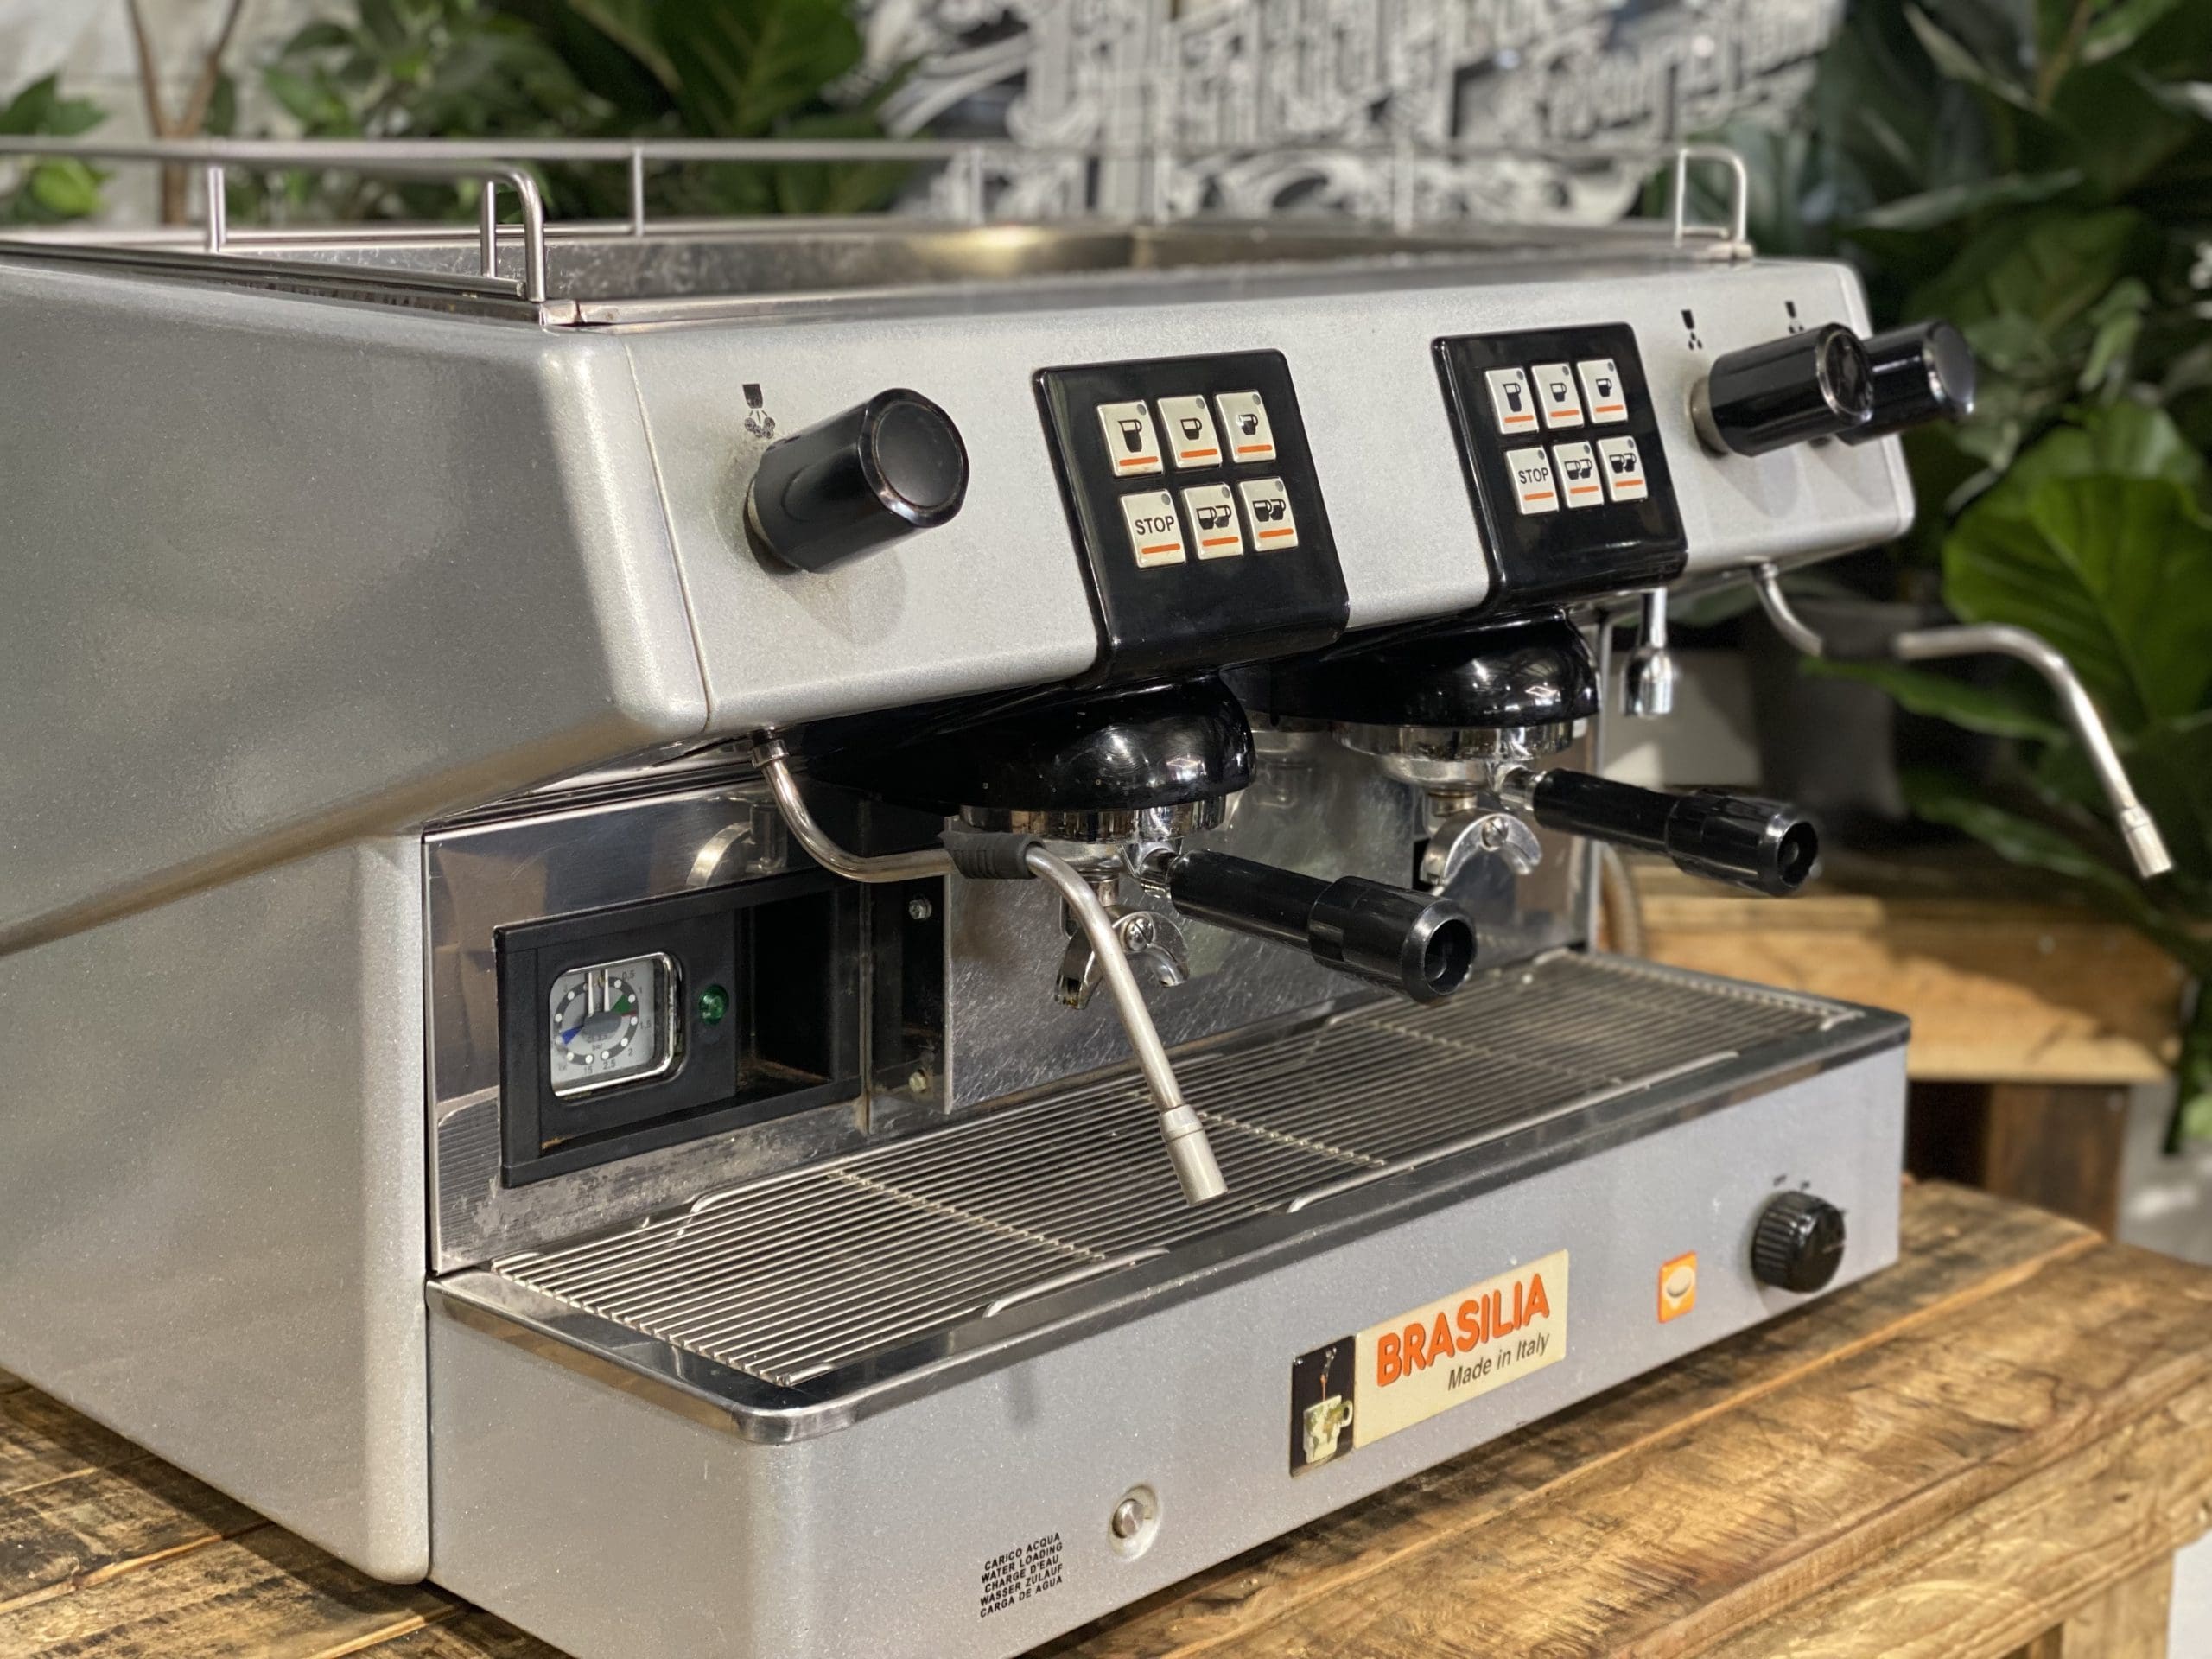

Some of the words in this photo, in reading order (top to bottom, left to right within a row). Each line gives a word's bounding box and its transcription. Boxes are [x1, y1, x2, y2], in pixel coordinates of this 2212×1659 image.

[1518, 467, 1548, 484] STOP
[1135, 516, 1174, 535] STOP
[1377, 1273, 1550, 1388] BRASILIA
[1448, 1357, 1492, 1391] Made
[1497, 1348, 1511, 1370] in
[1516, 1332, 1550, 1362] Italy
[981, 1562, 1015, 1584] WATER
[1020, 1541, 1063, 1567] LOADING
[984, 1548, 1023, 1571] CARICO
[1026, 1532, 1060, 1554] ACQUA
[980, 1581, 1021, 1607] WASSER
[1025, 1563, 1063, 1587] ZULAUF
[985, 1568, 1026, 1593] CHARGE
[1030, 1554, 1059, 1574] D'EAU
[980, 1595, 1015, 1618] CARGA
[1019, 1588, 1032, 1601] DE
[1035, 1575, 1063, 1594] AGUA
